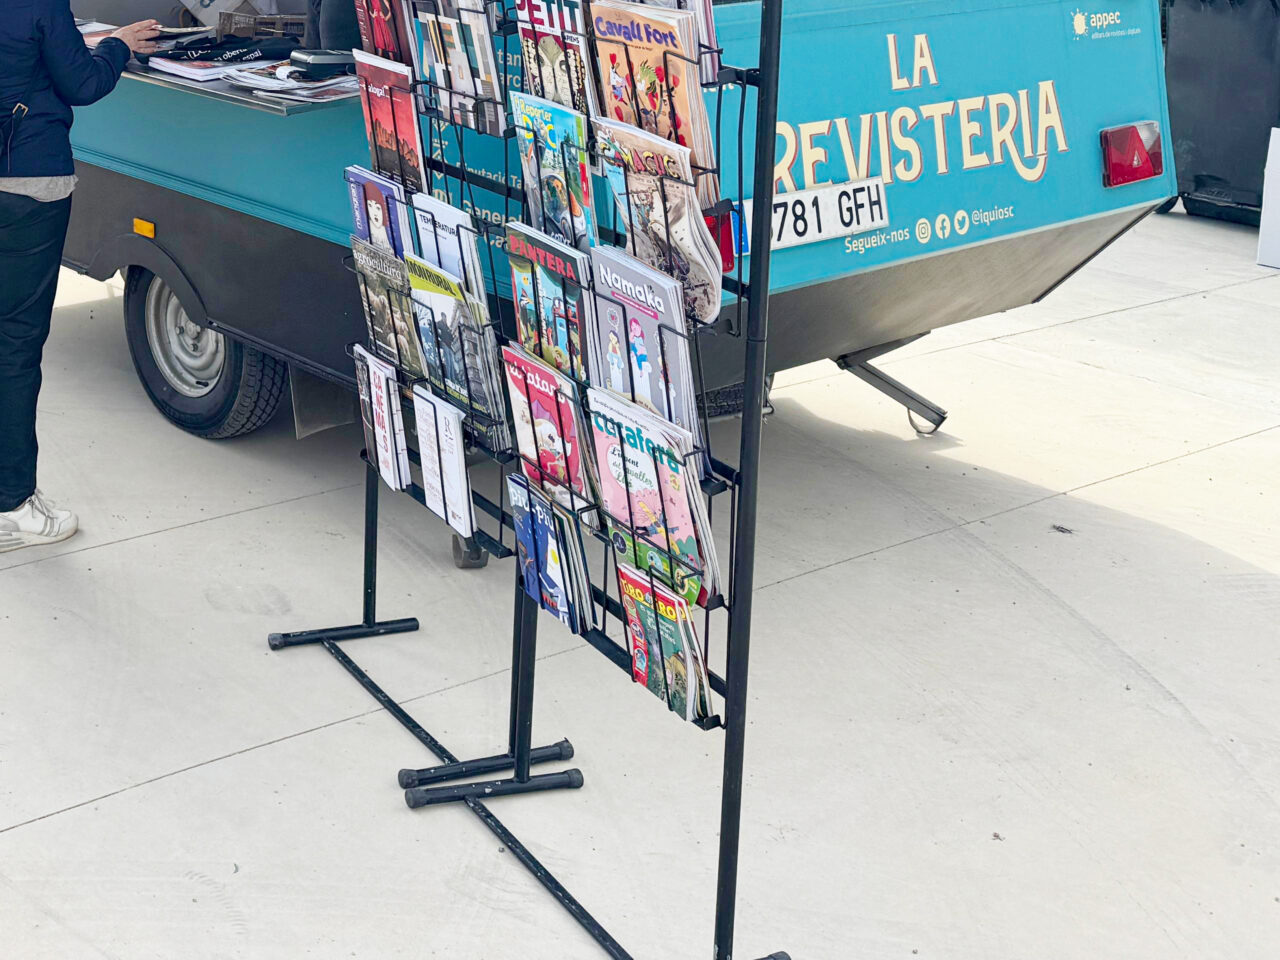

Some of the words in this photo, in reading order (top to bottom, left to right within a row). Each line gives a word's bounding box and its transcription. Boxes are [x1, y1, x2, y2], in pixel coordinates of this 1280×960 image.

[594, 15, 644, 43] Cavall
[643, 22, 678, 50] Fort
[1090, 9, 1121, 30] appec
[886, 33, 938, 91] LA
[773, 80, 1069, 192] REVISTERIA
[419, 213, 459, 237] TEMERATUR
[770, 196, 822, 242] 781
[838, 183, 884, 229] GFH
[844, 226, 910, 255] Segueix-nos
[972, 204, 1015, 225] @iquiosc
[509, 234, 577, 282] PANTERA
[598, 262, 666, 315] Namaka
